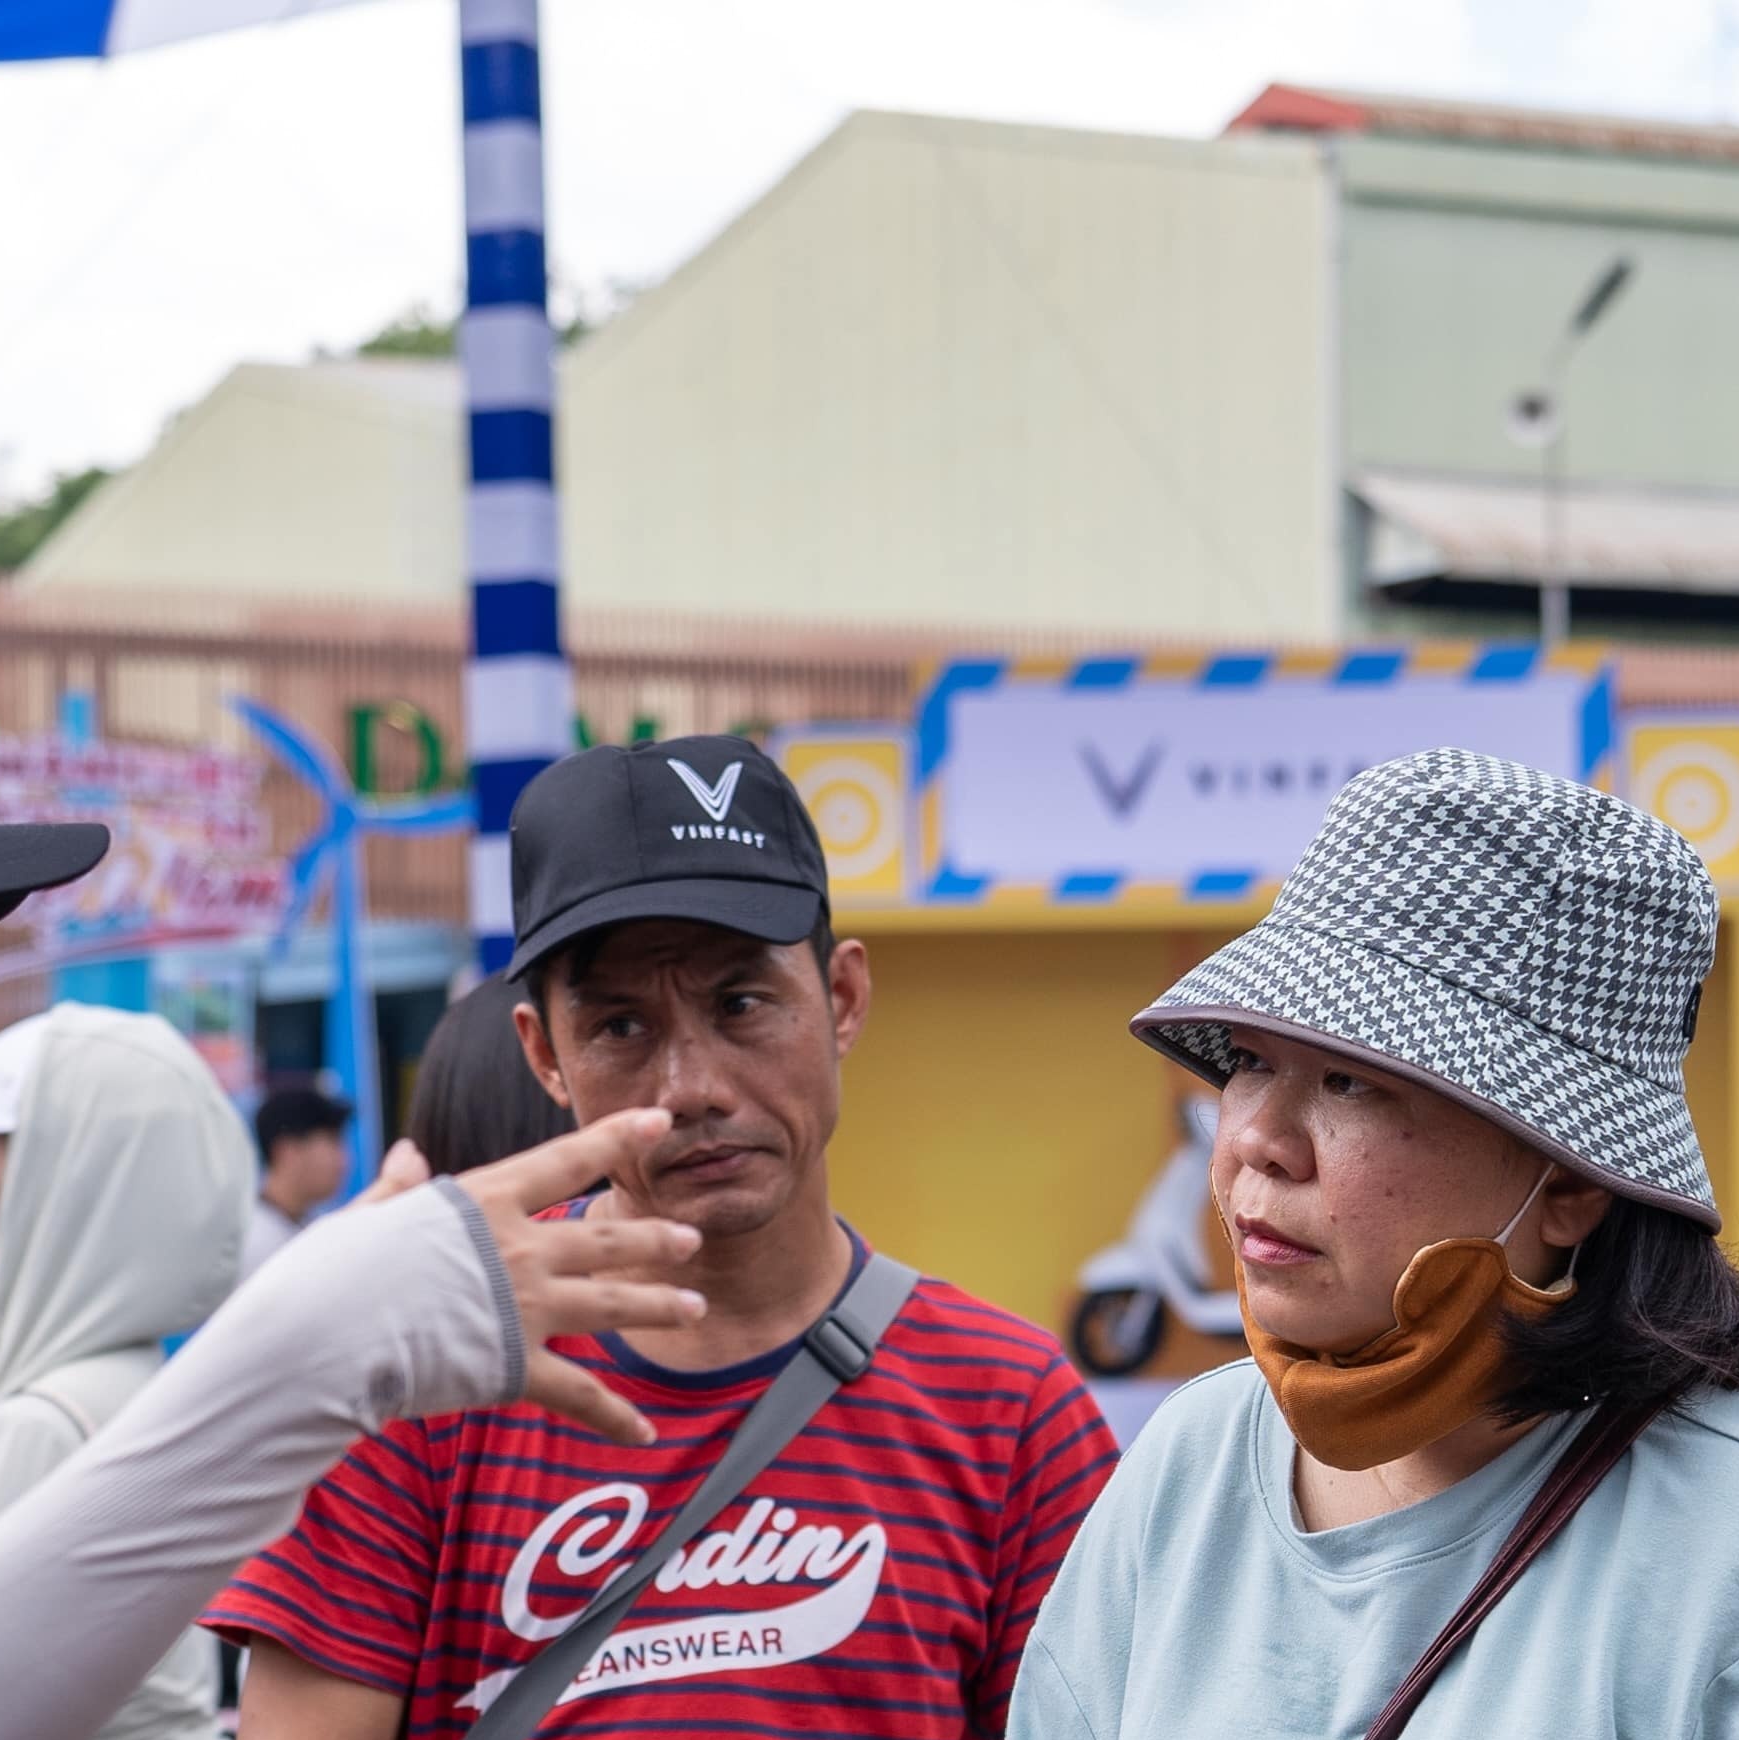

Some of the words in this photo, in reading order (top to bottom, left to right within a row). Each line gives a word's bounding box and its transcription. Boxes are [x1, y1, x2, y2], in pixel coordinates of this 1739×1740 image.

[1188, 757, 1368, 798] VINF
[670, 823, 766, 849] VINFAST
[572, 1626, 784, 1686] EANSWEAR
